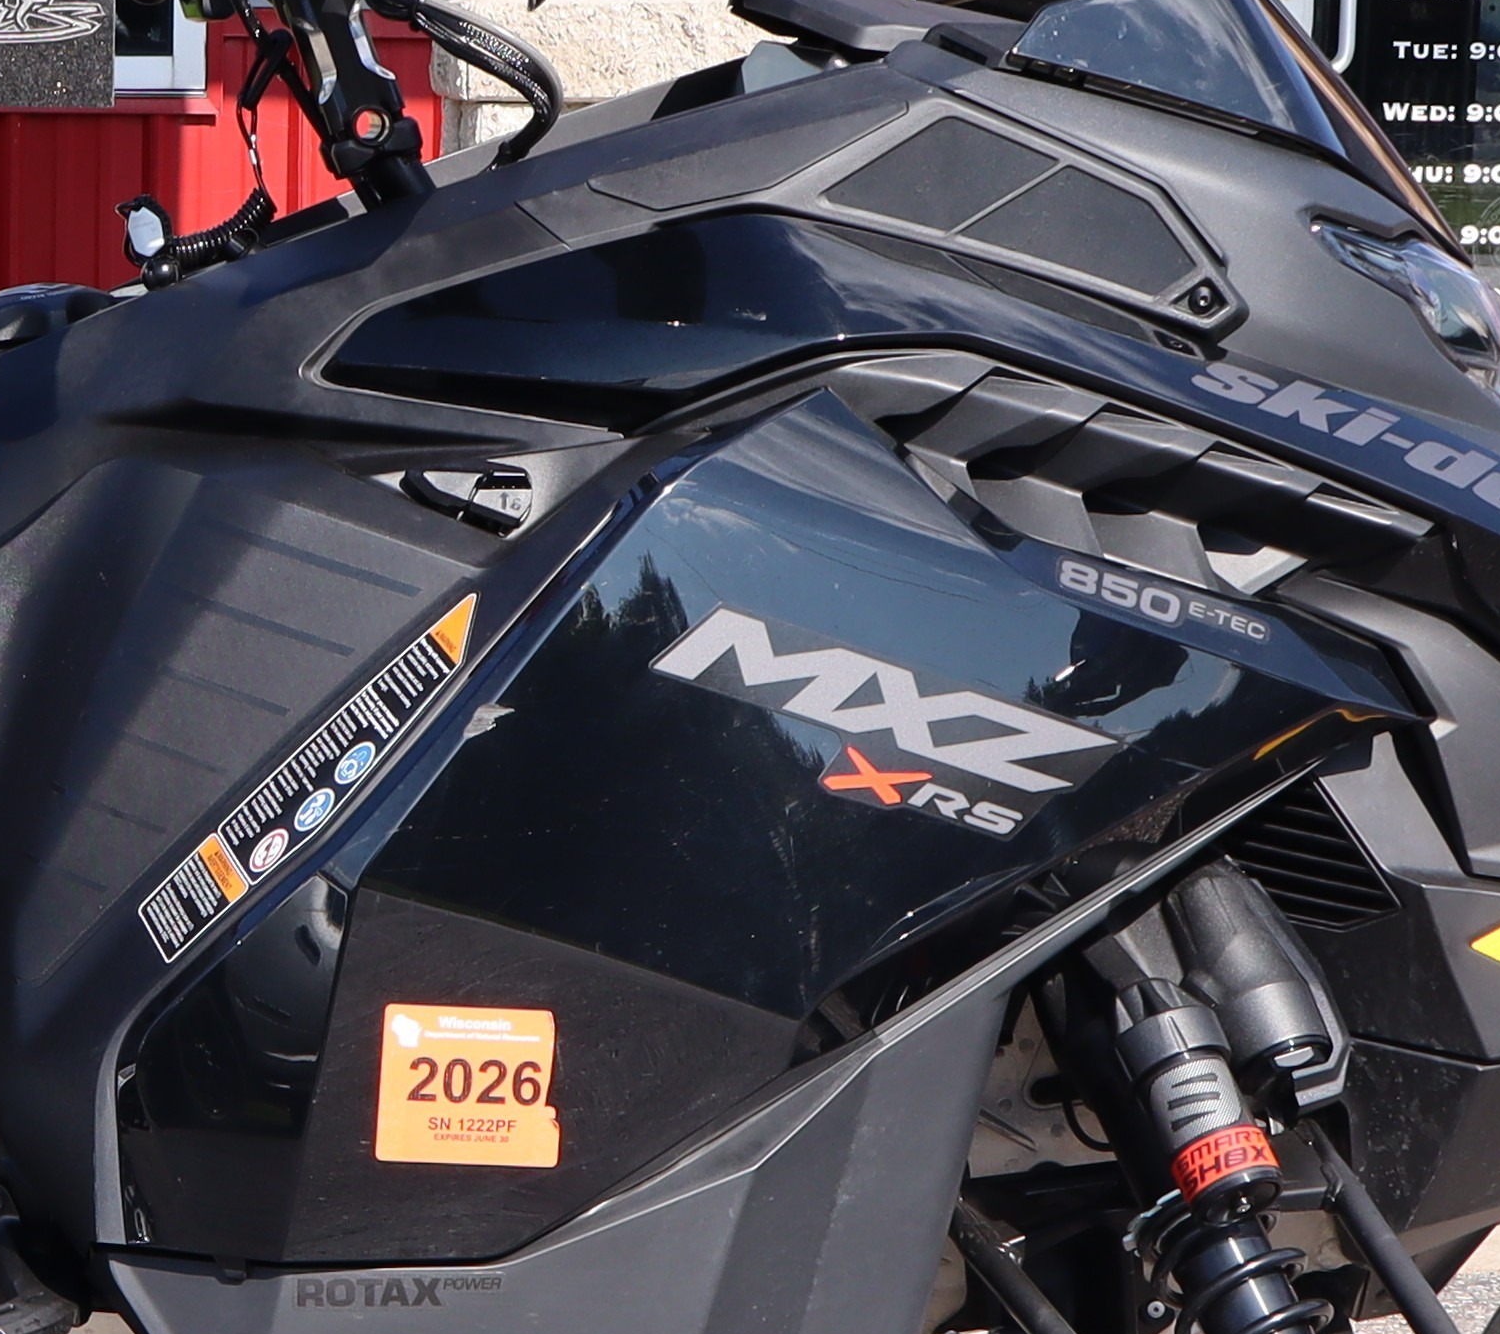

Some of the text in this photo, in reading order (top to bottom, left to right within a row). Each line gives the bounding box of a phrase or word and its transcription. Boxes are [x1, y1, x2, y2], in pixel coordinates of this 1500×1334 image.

[1393, 40, 1458, 60] TUE:
[1382, 102, 1456, 122] WED:
[1407, 165, 1454, 184] HU:
[1058, 557, 1268, 642] 850 E-TEC
[651, 605, 1121, 792] MXZ
[438, 1015, 512, 1032] Wisconsin
[406, 1056, 543, 1107] 2026
[427, 1116, 518, 1133] SN 1222PF
[433, 1132, 472, 1143] EXPIRES
[473, 1133, 497, 1143] JUNE
[1176, 1130, 1263, 1171] SMART
[295, 1276, 503, 1308] ROTAX POWER
